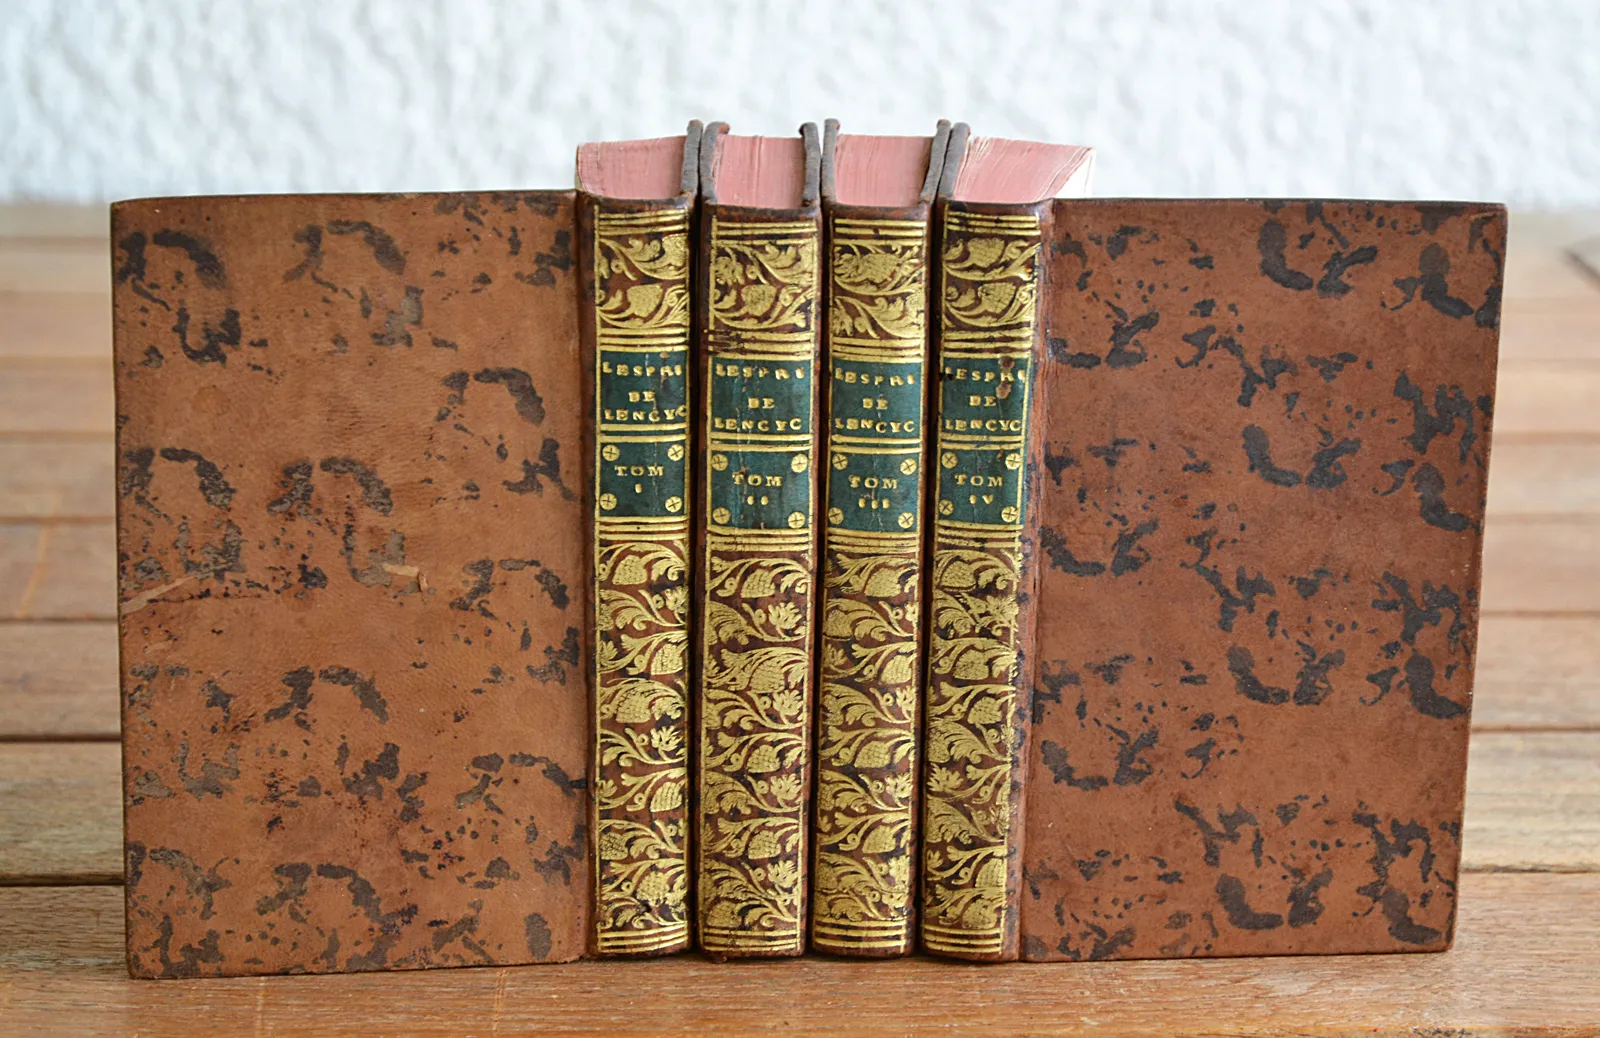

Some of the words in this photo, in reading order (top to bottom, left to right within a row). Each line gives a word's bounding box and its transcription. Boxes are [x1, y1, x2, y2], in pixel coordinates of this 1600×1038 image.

[628, 391, 656, 402] DE
[748, 397, 775, 409] DE
[969, 395, 997, 407] DE
[714, 417, 802, 432] LENCYC
[834, 418, 915, 433] LENCYC
[614, 465, 664, 477] TOM
[732, 471, 783, 487] TOM
[848, 475, 899, 490] TOM
[954, 474, 1003, 487] TOM
